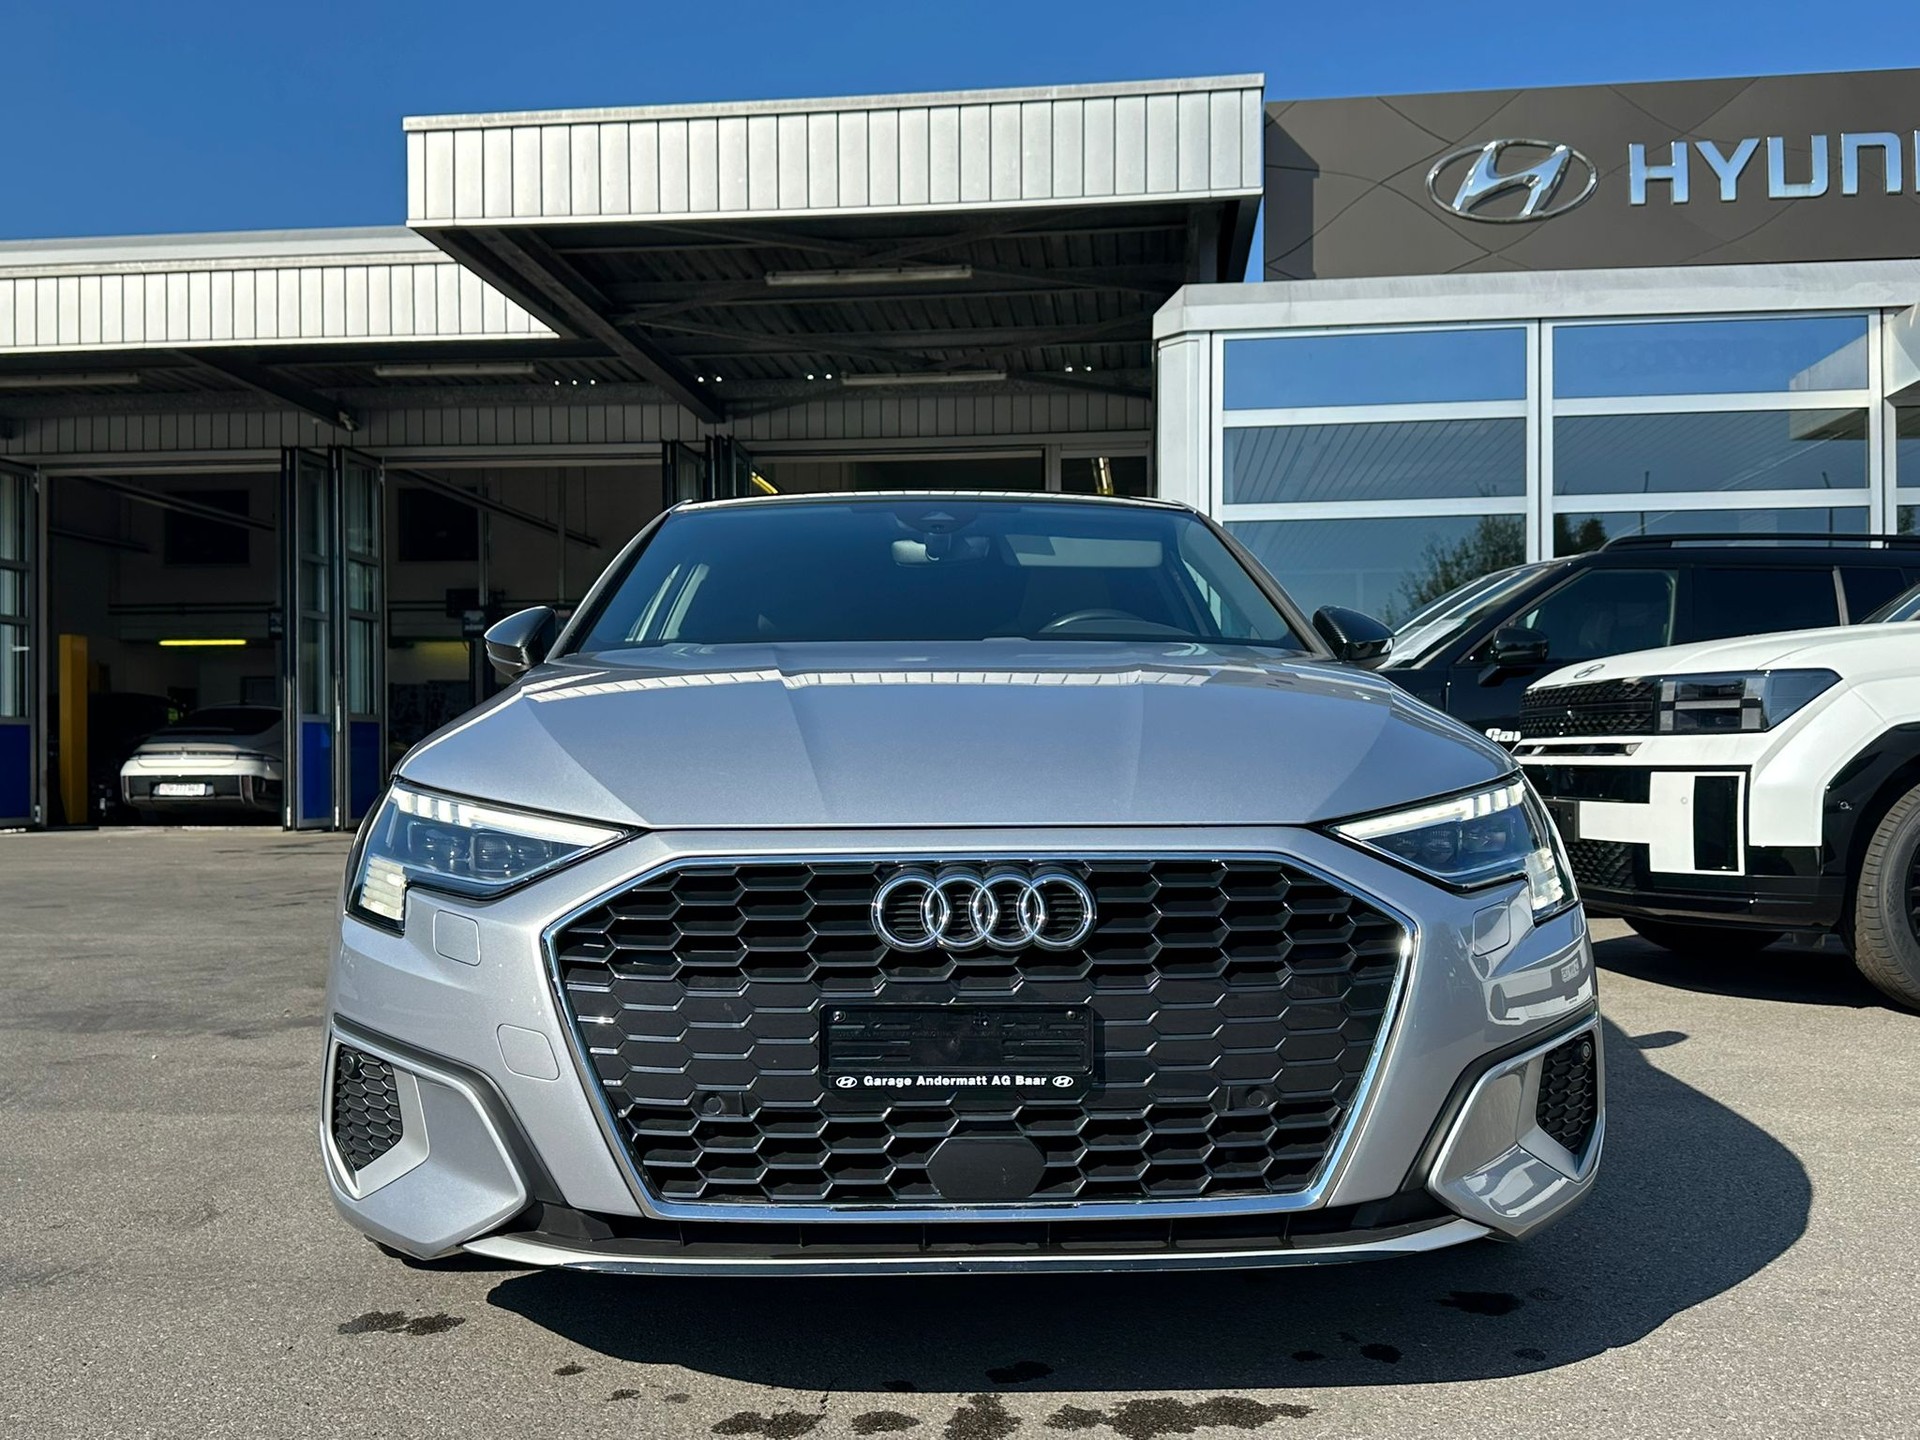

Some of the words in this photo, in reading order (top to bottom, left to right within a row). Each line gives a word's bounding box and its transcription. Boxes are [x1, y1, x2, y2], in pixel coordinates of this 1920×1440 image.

[1628, 130, 1920, 205] HYUN
[863, 1075, 913, 1088] Garage
[916, 1075, 988, 1086] Andermatt
[991, 1075, 1011, 1086] AG
[1015, 1075, 1047, 1086] Baar
